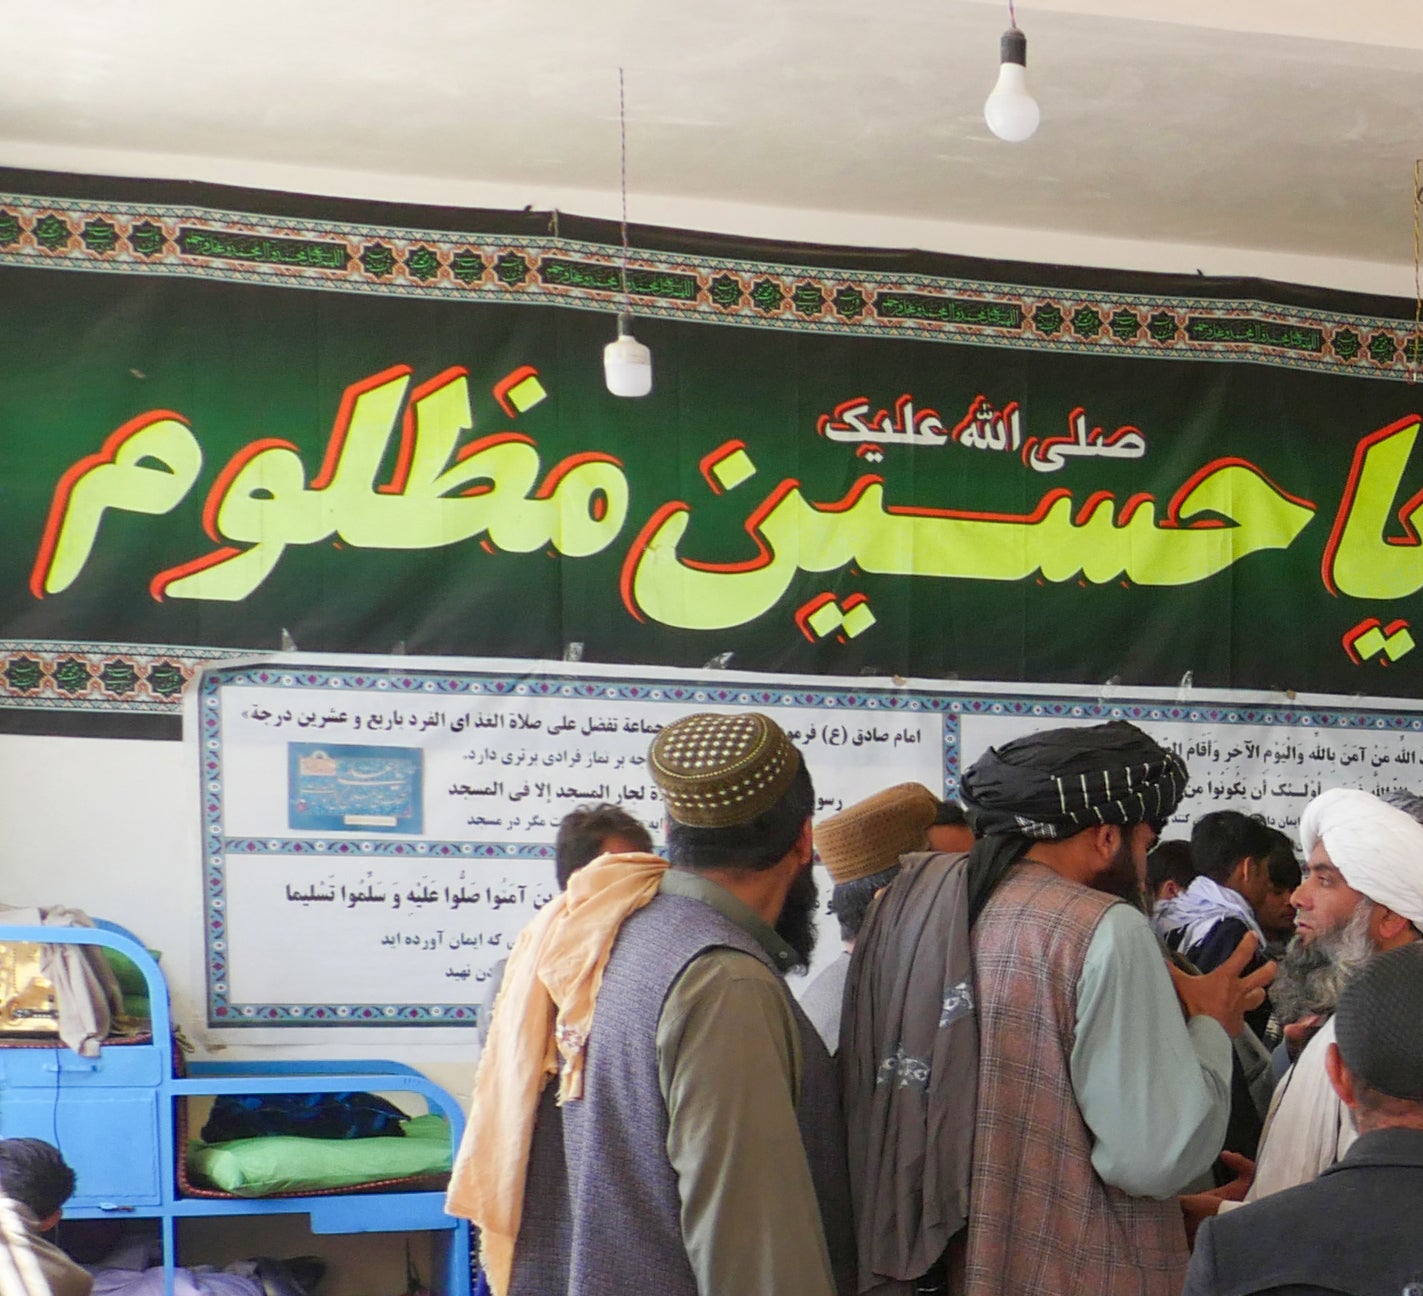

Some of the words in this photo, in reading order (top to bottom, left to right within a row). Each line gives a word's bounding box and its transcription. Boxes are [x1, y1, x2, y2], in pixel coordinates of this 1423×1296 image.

[818, 394, 947, 462] علیک
[1024, 407, 1146, 473] صلی
[30, 365, 629, 603] مظلوم
[620, 440, 1319, 643] حسین
[353, 715, 362, 730] و
[786, 722, 817, 746] فرمو
[852, 726, 890, 747] صادق
[893, 727, 922, 748] امام
[501, 747, 539, 769] برتری
[542, 749, 582, 769] فرادی
[585, 750, 609, 769] نماز
[612, 754, 625, 770] بر
[448, 780, 504, 800] المسجد
[555, 784, 611, 803] المسجد
[816, 796, 843, 812] رسو
[466, 814, 502, 831] مسجد
[506, 815, 522, 832] در
[380, 934, 402, 948] اید
[449, 933, 484, 950] ایمان
[487, 932, 502, 948] که
